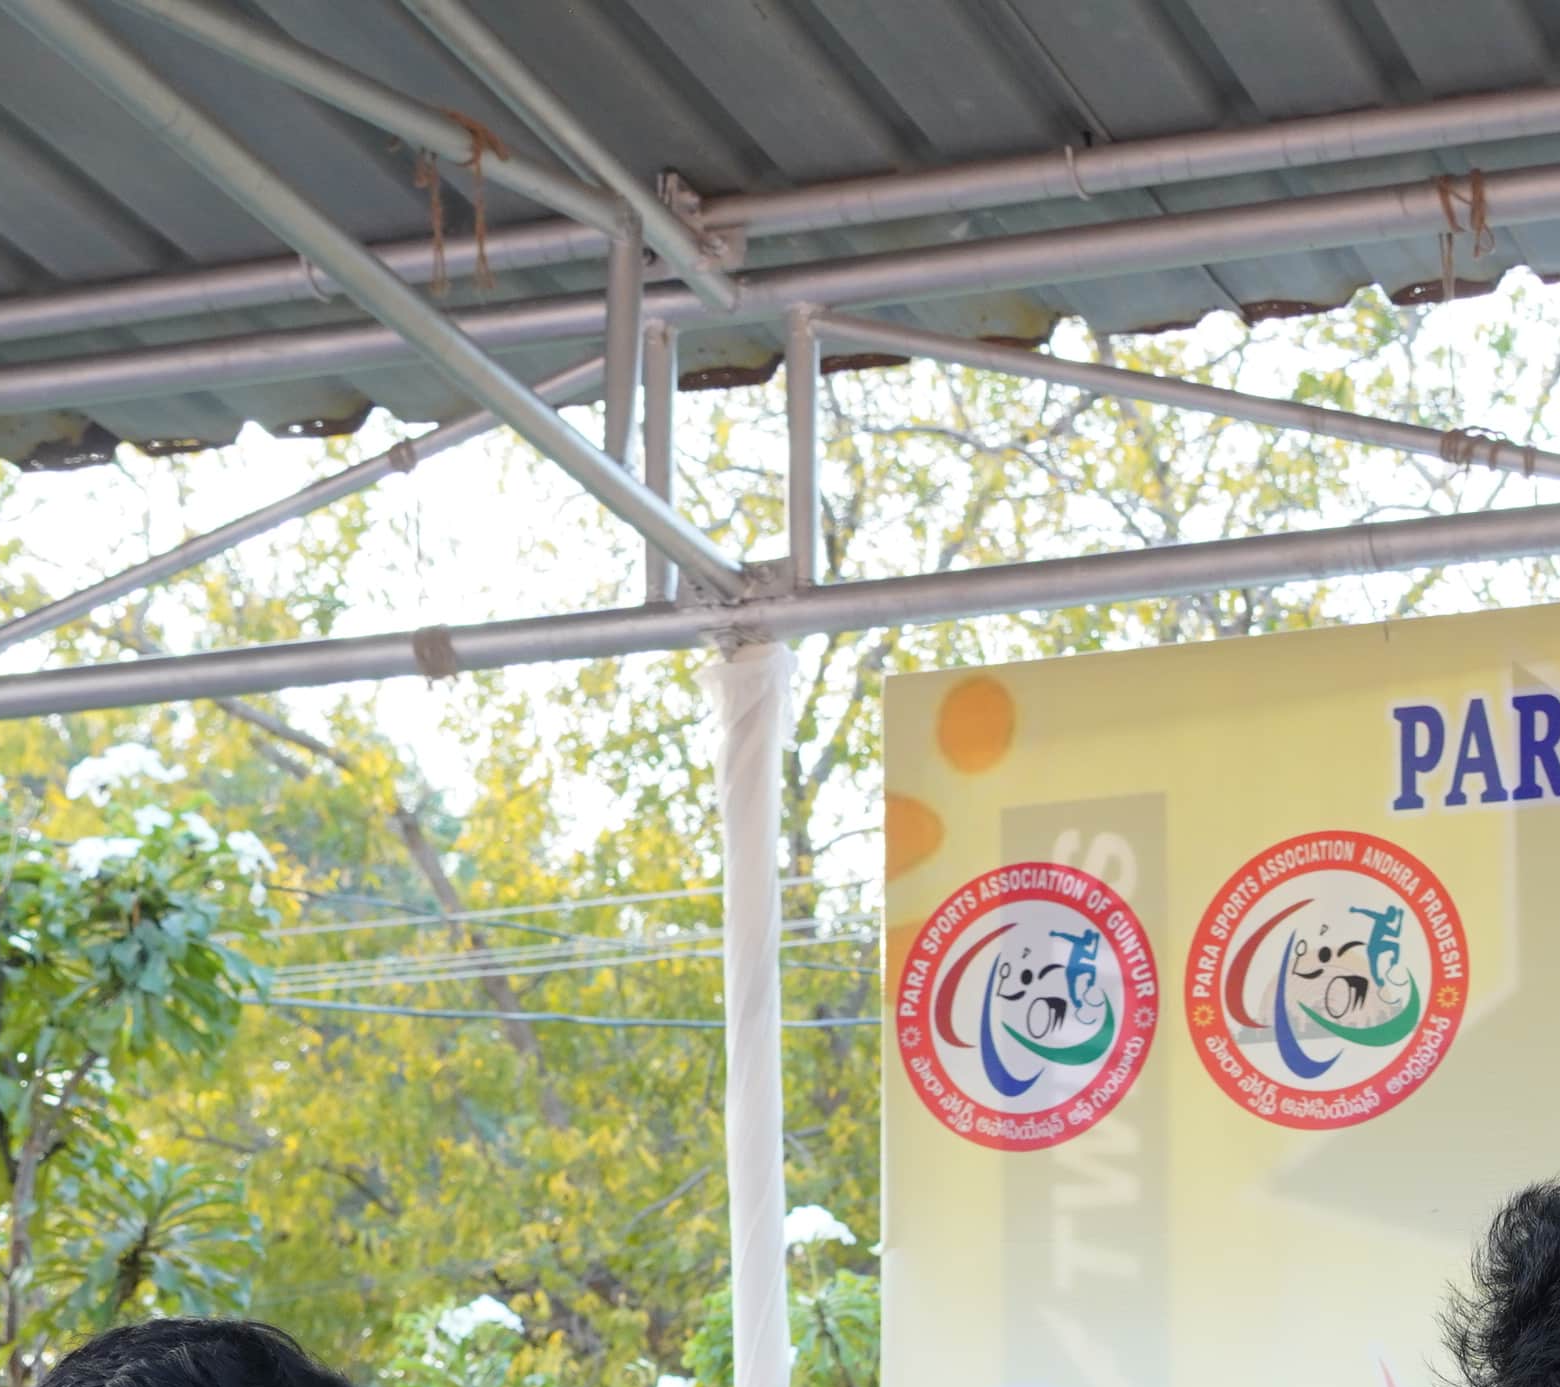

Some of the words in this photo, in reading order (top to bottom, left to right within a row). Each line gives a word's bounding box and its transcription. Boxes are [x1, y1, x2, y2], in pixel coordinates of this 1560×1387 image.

[899, 959, 932, 1018] PARA
[921, 889, 977, 955] SPORTS
[978, 867, 1089, 902] ASSOCIATION
[1087, 889, 1112, 914] OF
[1105, 910, 1157, 999] GUNTUR
[1191, 944, 1220, 999] PARA
[1209, 875, 1261, 940] SPORTS
[1257, 839, 1357, 886] ASSOCIATION
[1360, 845, 1422, 898] ANDHRA
[1417, 887, 1464, 980] PRADESH
